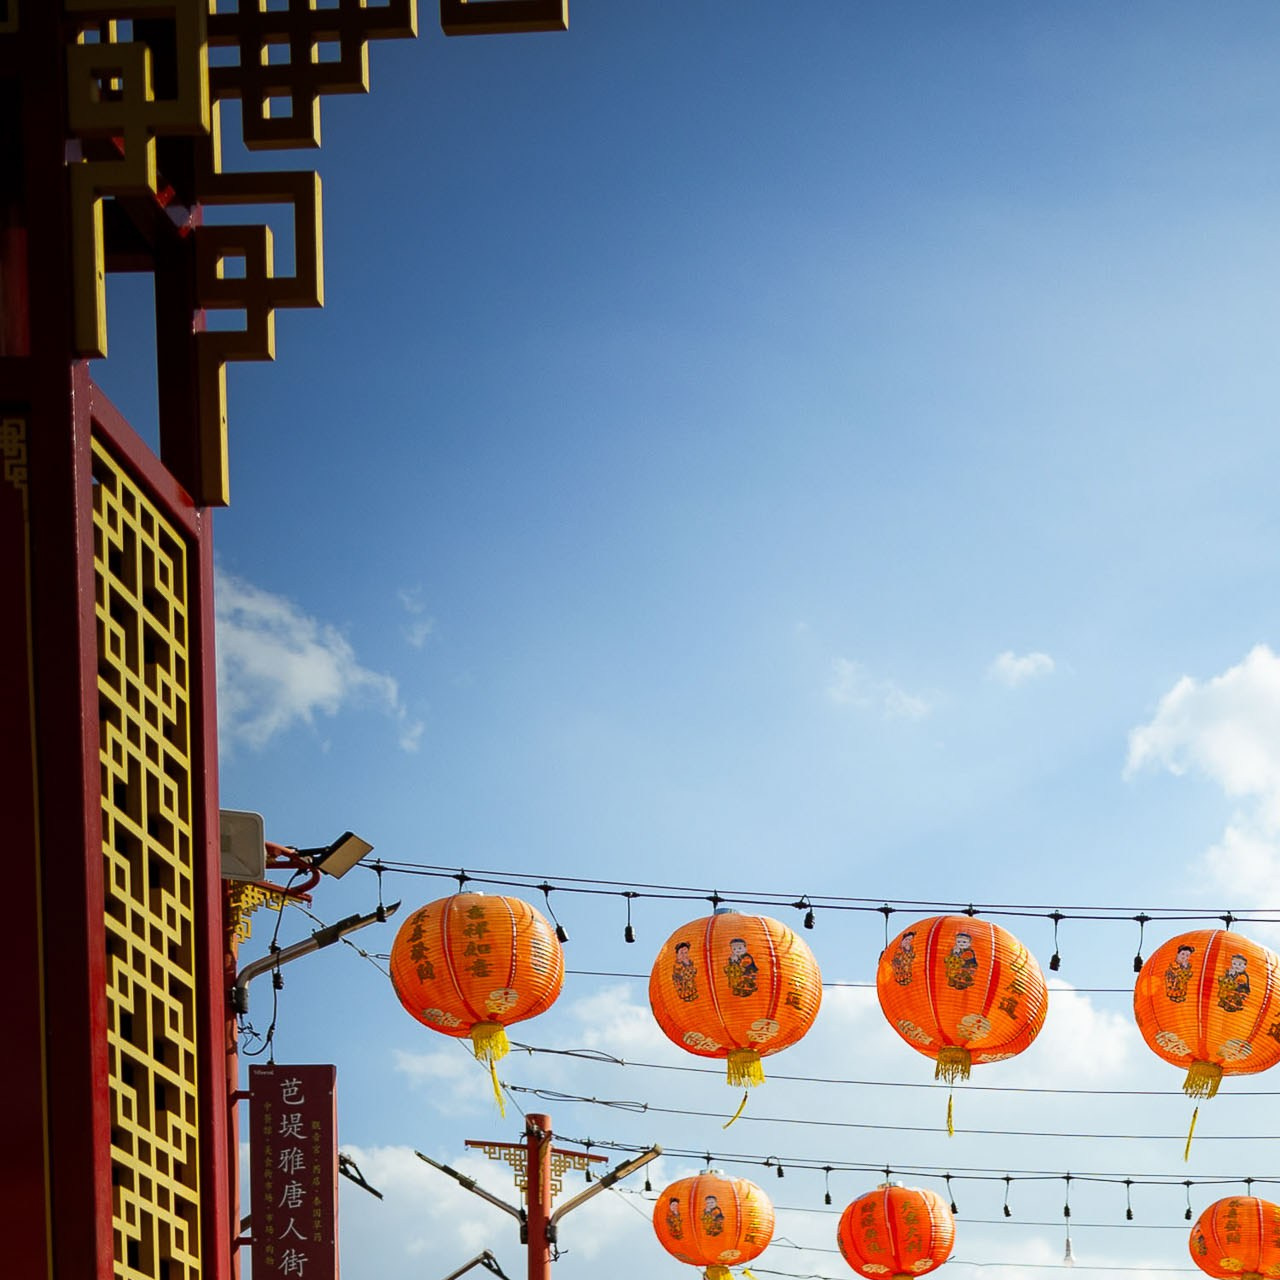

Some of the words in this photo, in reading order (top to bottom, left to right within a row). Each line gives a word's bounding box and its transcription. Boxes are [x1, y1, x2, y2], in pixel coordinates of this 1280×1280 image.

[462, 905, 494, 978] 吉祥如意
[277, 1077, 309, 1278] 芭堤雅唐人街
